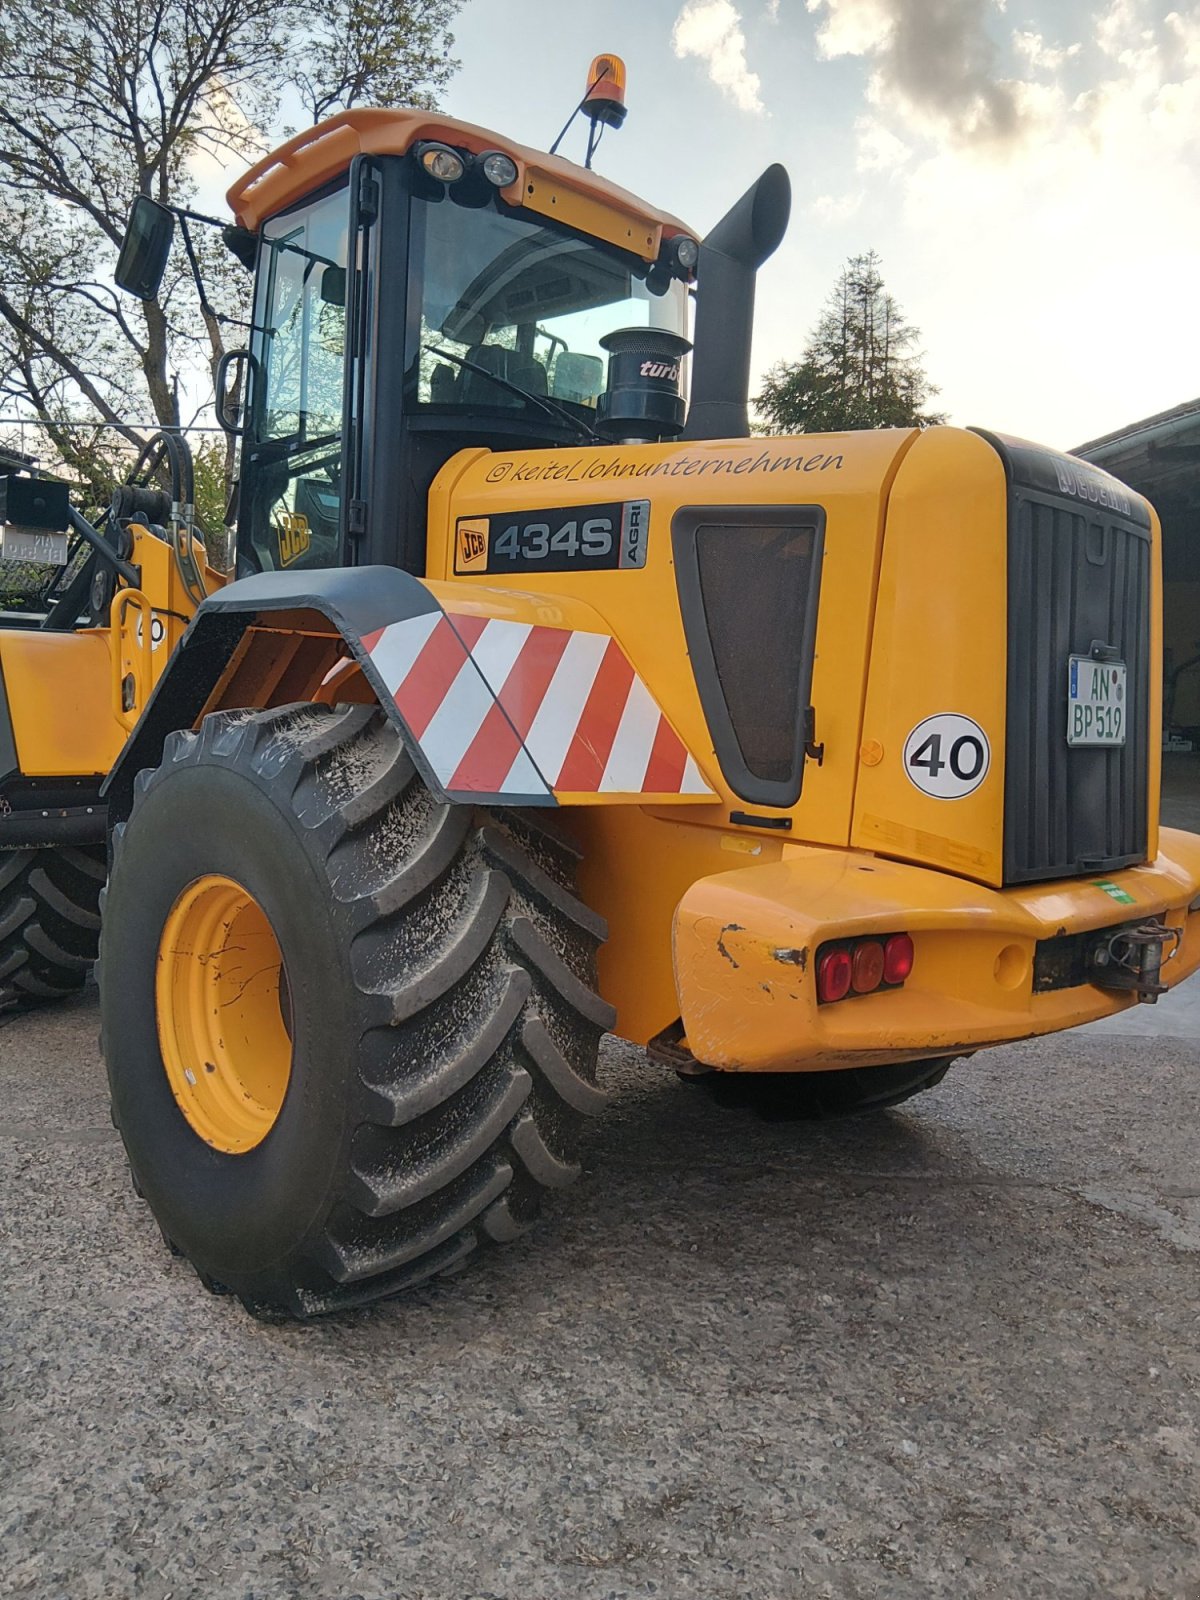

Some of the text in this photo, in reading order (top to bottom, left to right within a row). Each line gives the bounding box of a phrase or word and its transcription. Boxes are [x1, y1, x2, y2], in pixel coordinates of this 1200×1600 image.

[280, 516, 308, 560] JCB
[464, 533, 484, 559] JCB
[495, 518, 613, 560] 434S
[628, 506, 641, 562] AGRI
[1091, 668, 1110, 701] AN
[1074, 704, 1122, 738] BP 519
[910, 733, 984, 781] 40
